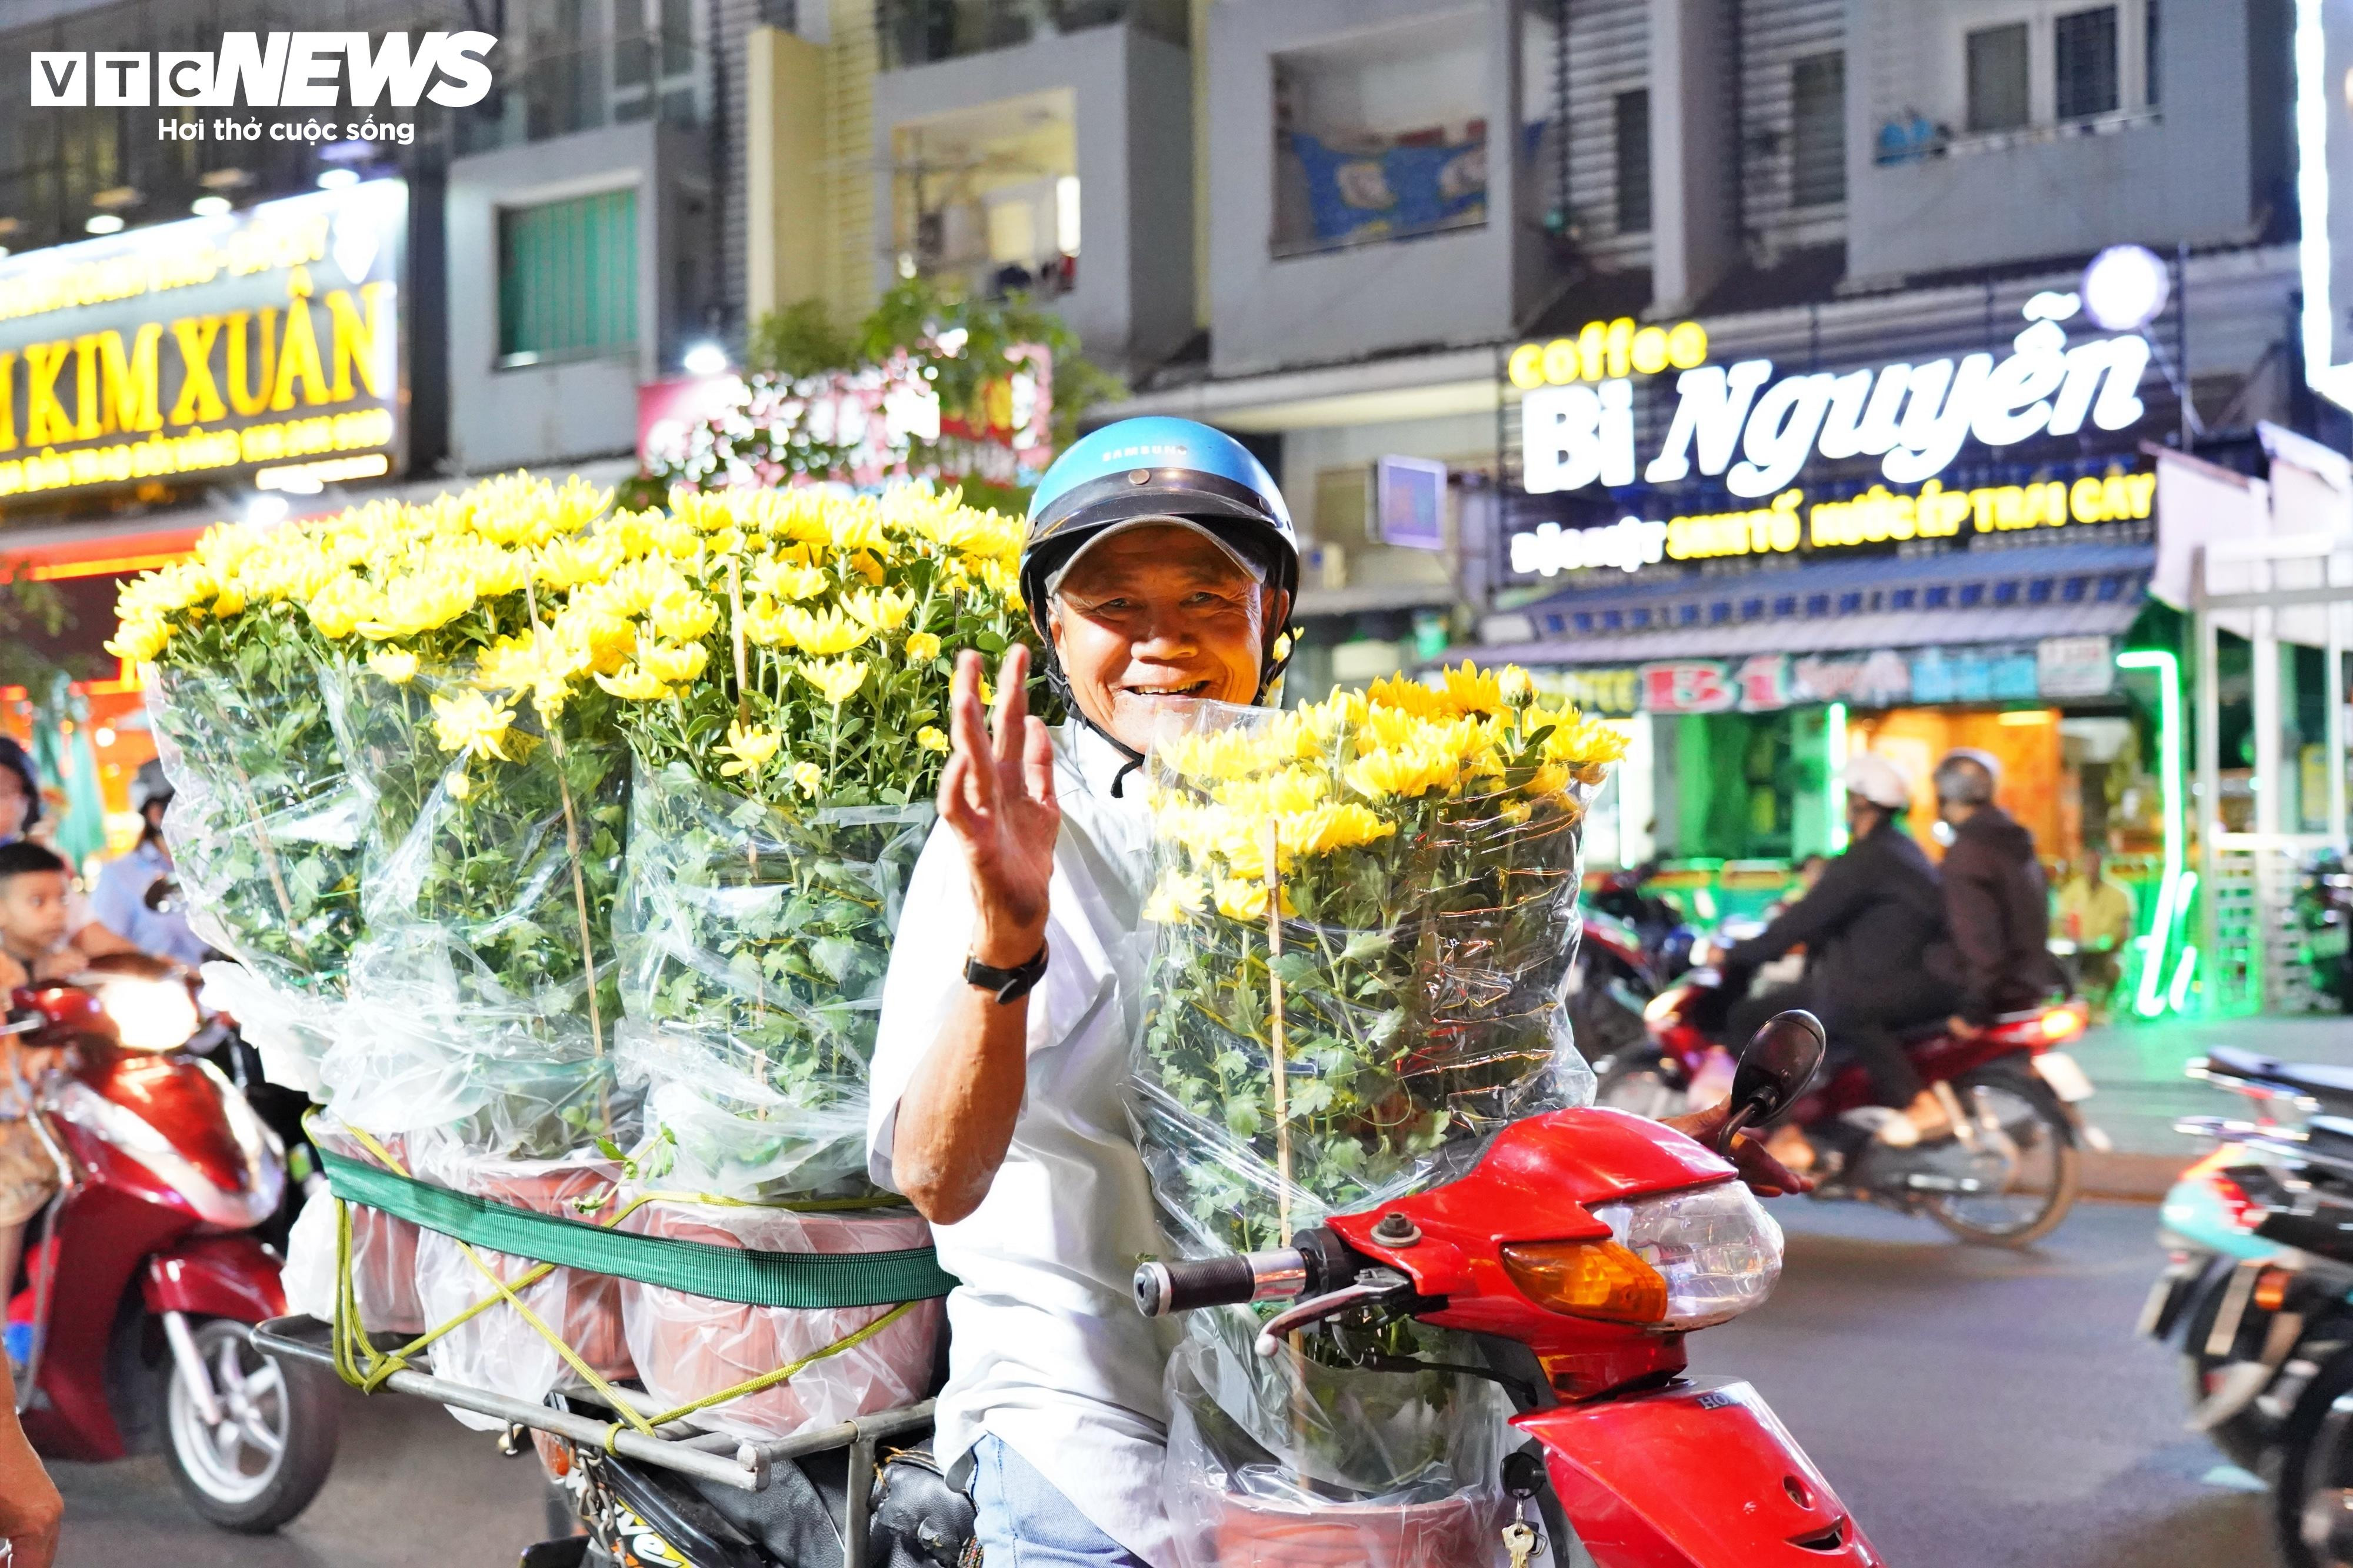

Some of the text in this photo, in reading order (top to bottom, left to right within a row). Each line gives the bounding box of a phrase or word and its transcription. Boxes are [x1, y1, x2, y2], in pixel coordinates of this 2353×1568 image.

[25, 321, 164, 449] KIM
[170, 265, 396, 426] XUÂN
[1508, 316, 1708, 389] coffee
[1522, 291, 2151, 498] Bi Nguyễn
